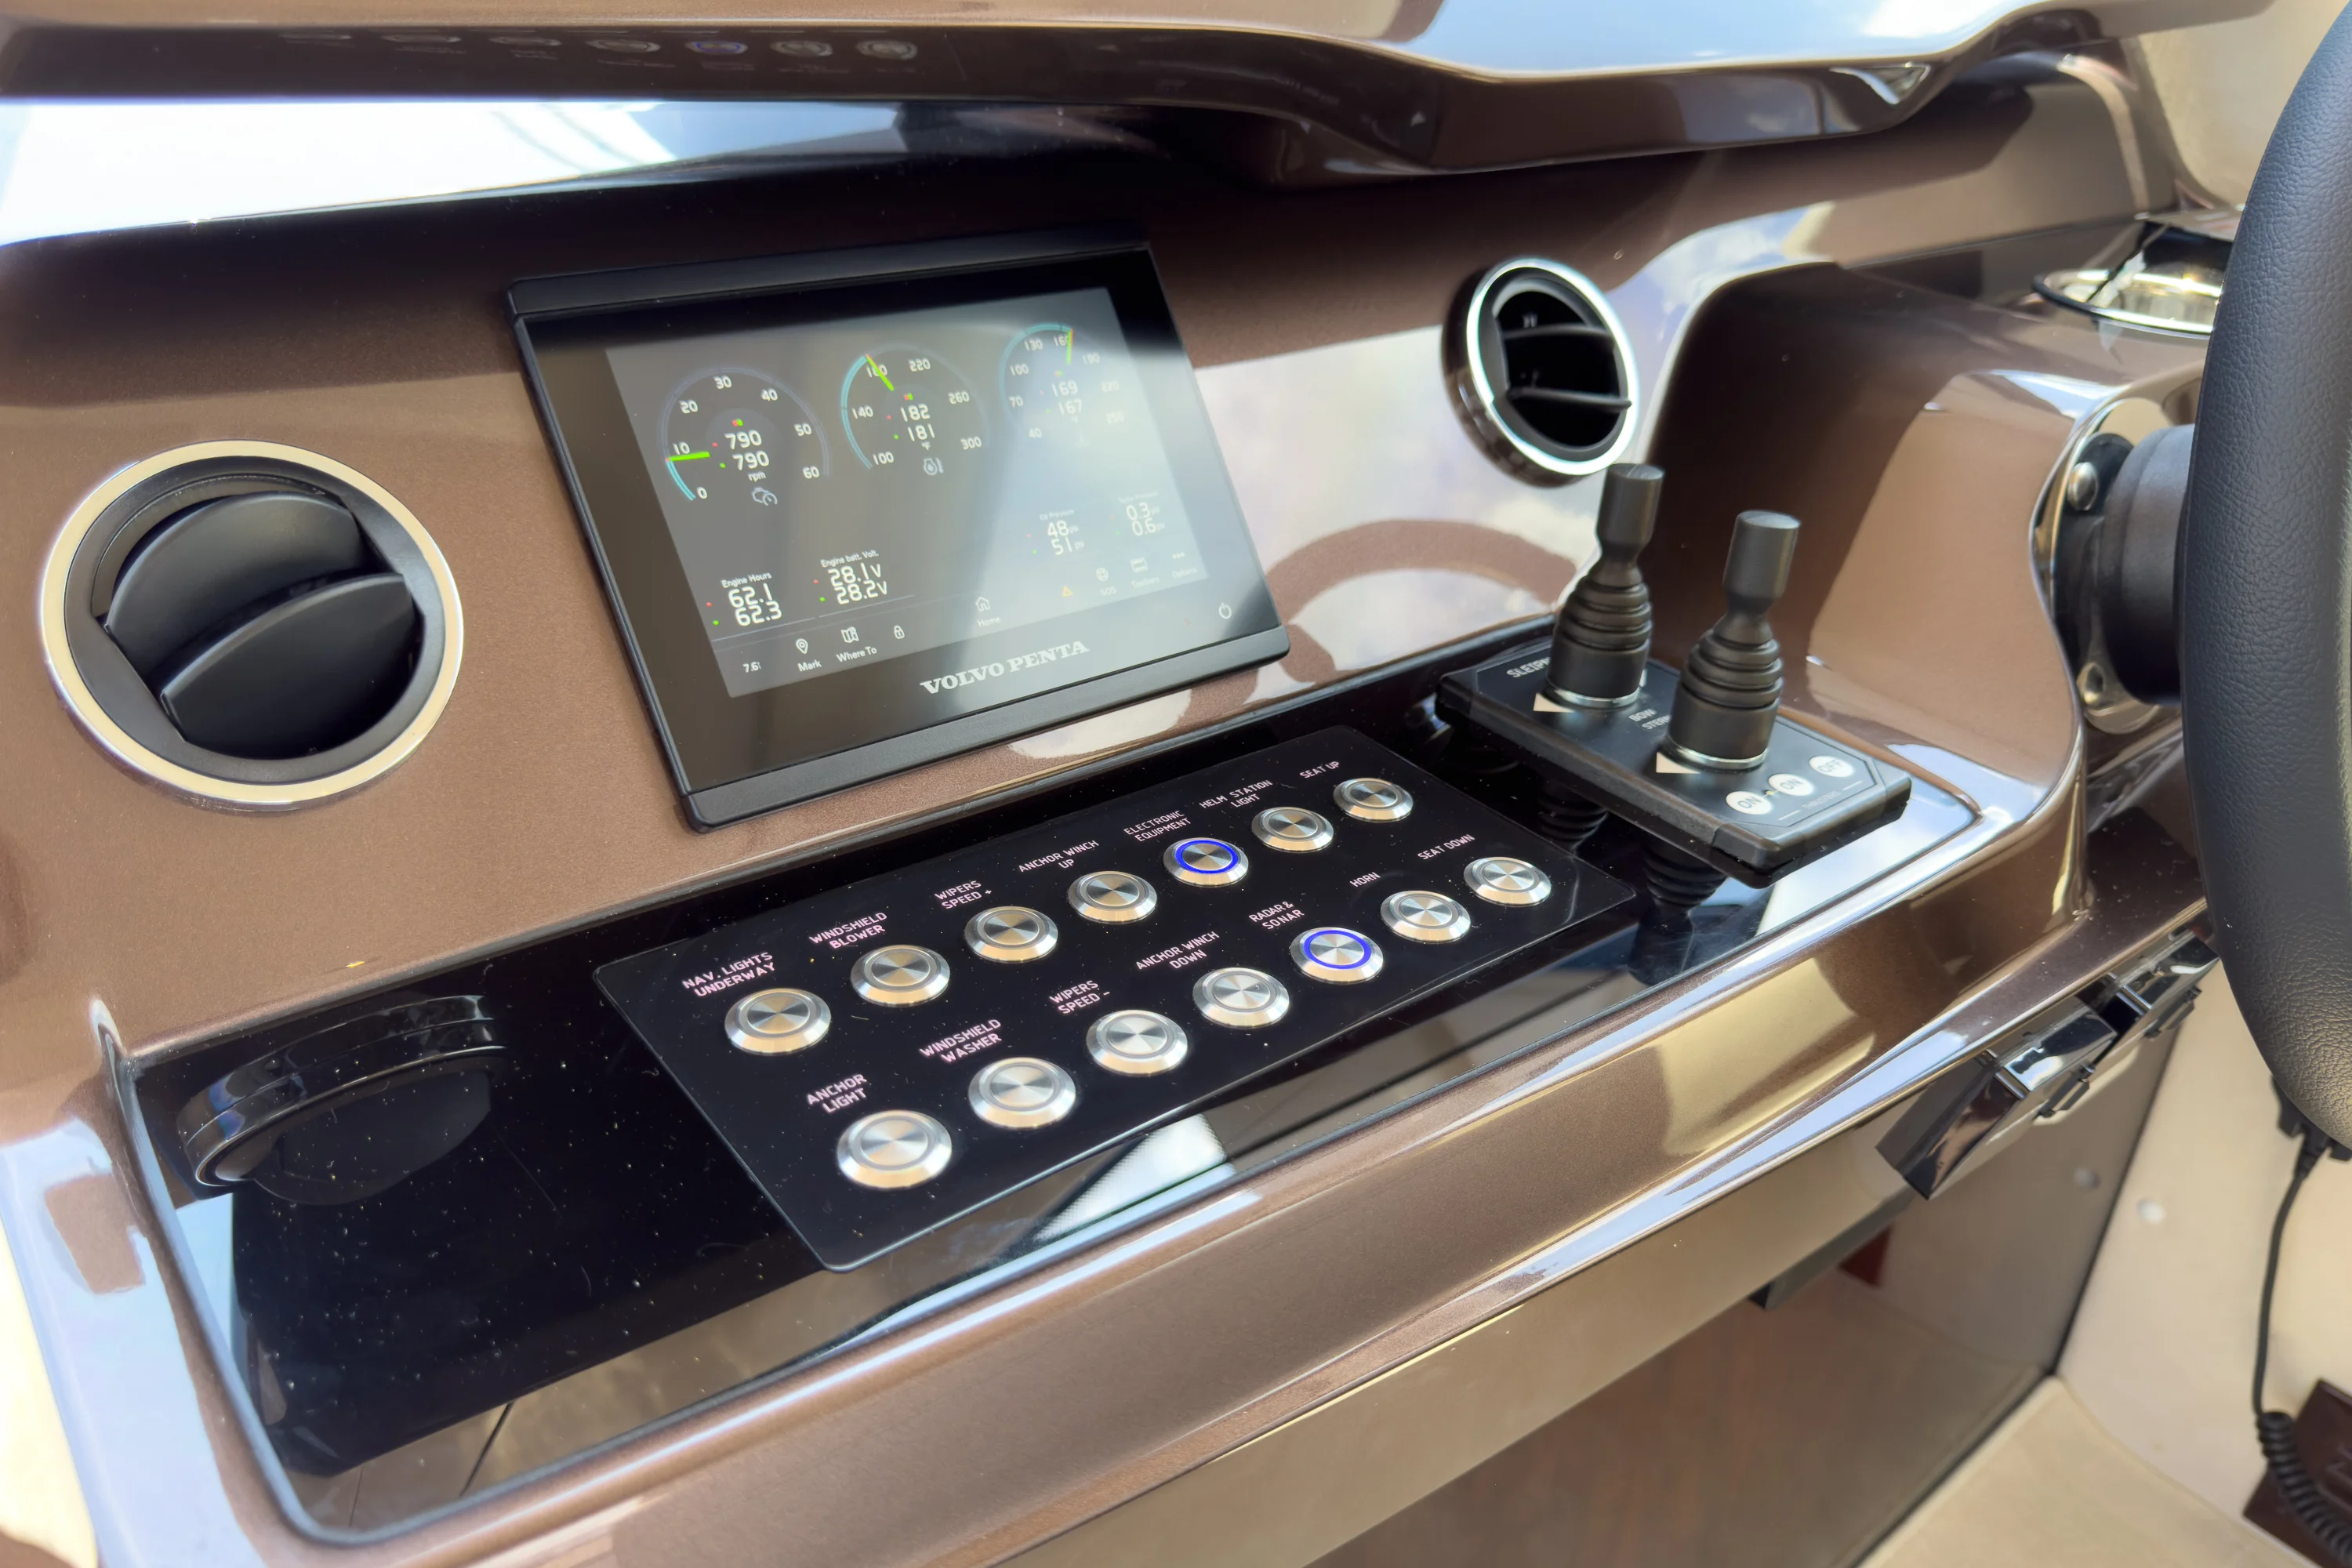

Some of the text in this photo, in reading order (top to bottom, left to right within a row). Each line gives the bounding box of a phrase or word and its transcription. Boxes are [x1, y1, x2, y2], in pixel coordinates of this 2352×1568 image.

[1024, 337, 1044, 351] 130
[908, 358, 931, 372] 220
[1009, 363, 1029, 376] 100
[713, 376, 732, 390] 30
[1051, 379, 1079, 397] 169
[760, 388, 779, 401] 40
[948, 390, 970, 405] 260
[1008, 395, 1024, 408] 70
[680, 399, 699, 414] 20
[852, 405, 874, 419] 140
[900, 403, 931, 423] 182
[1058, 398, 1083, 416] 167
[794, 423, 812, 436] 50
[907, 423, 935, 442] 181
[1029, 426, 1043, 439] 40
[672, 441, 690, 456] 10
[724, 430, 762, 450] 790
[960, 436, 982, 450] 300
[731, 450, 770, 471] 790
[872, 451, 895, 465] 100
[748, 470, 766, 481] rpm
[802, 466, 820, 480] 60
[696, 487, 708, 499] 0
[1127, 502, 1150, 521] 0.3
[1047, 521, 1069, 538] 48
[1132, 517, 1156, 536] 0.6
[1051, 536, 1073, 555] 51
[820, 550, 879, 568] Engine batt. Volt.
[720, 572, 772, 588] Engine Hours
[728, 583, 773, 608] 62.1
[735, 601, 782, 626] 62.3
[977, 615, 1001, 627] Home
[837, 646, 877, 662] Where To
[797, 659, 822, 672] Mark
[920, 641, 1091, 694] VOLVO PENTA
[1300, 760, 1341, 779] SEAT UP
[1819, 760, 1842, 773] OFF
[1780, 778, 1802, 790] ON
[1199, 779, 1273, 809] HELM STATION
[1231, 793, 1260, 808] LIGHT
[1737, 796, 1762, 809] ON
[1123, 810, 1185, 836] ELECTRONIC
[1134, 818, 1191, 843] EQUIPMENT
[1417, 833, 1475, 861] SEAT DOWN
[1018, 840, 1099, 873] ANCHOR WINCH
[1058, 858, 1075, 869] UP
[1349, 872, 1381, 887] HORN
[934, 880, 982, 901] WIPERS
[942, 891, 982, 909] SPEED
[808, 912, 887, 945] WINDSHIELD
[1262, 909, 1305, 931] SONAR
[829, 924, 886, 949] BLOWER
[1135, 931, 1220, 970] ANCHOR WINCH
[1169, 949, 1207, 970] DOWN
[681, 951, 774, 990] NAV. LIGHTS
[694, 961, 776, 997] UNDERWAY
[1049, 979, 1098, 1004] WIPERS
[1058, 993, 1101, 1014] SPEED
[919, 1018, 1002, 1058] WINDSHIELD
[941, 1033, 1002, 1063] WASHER
[806, 1073, 868, 1105] ANCHOR
[822, 1087, 868, 1113] LIGHT
